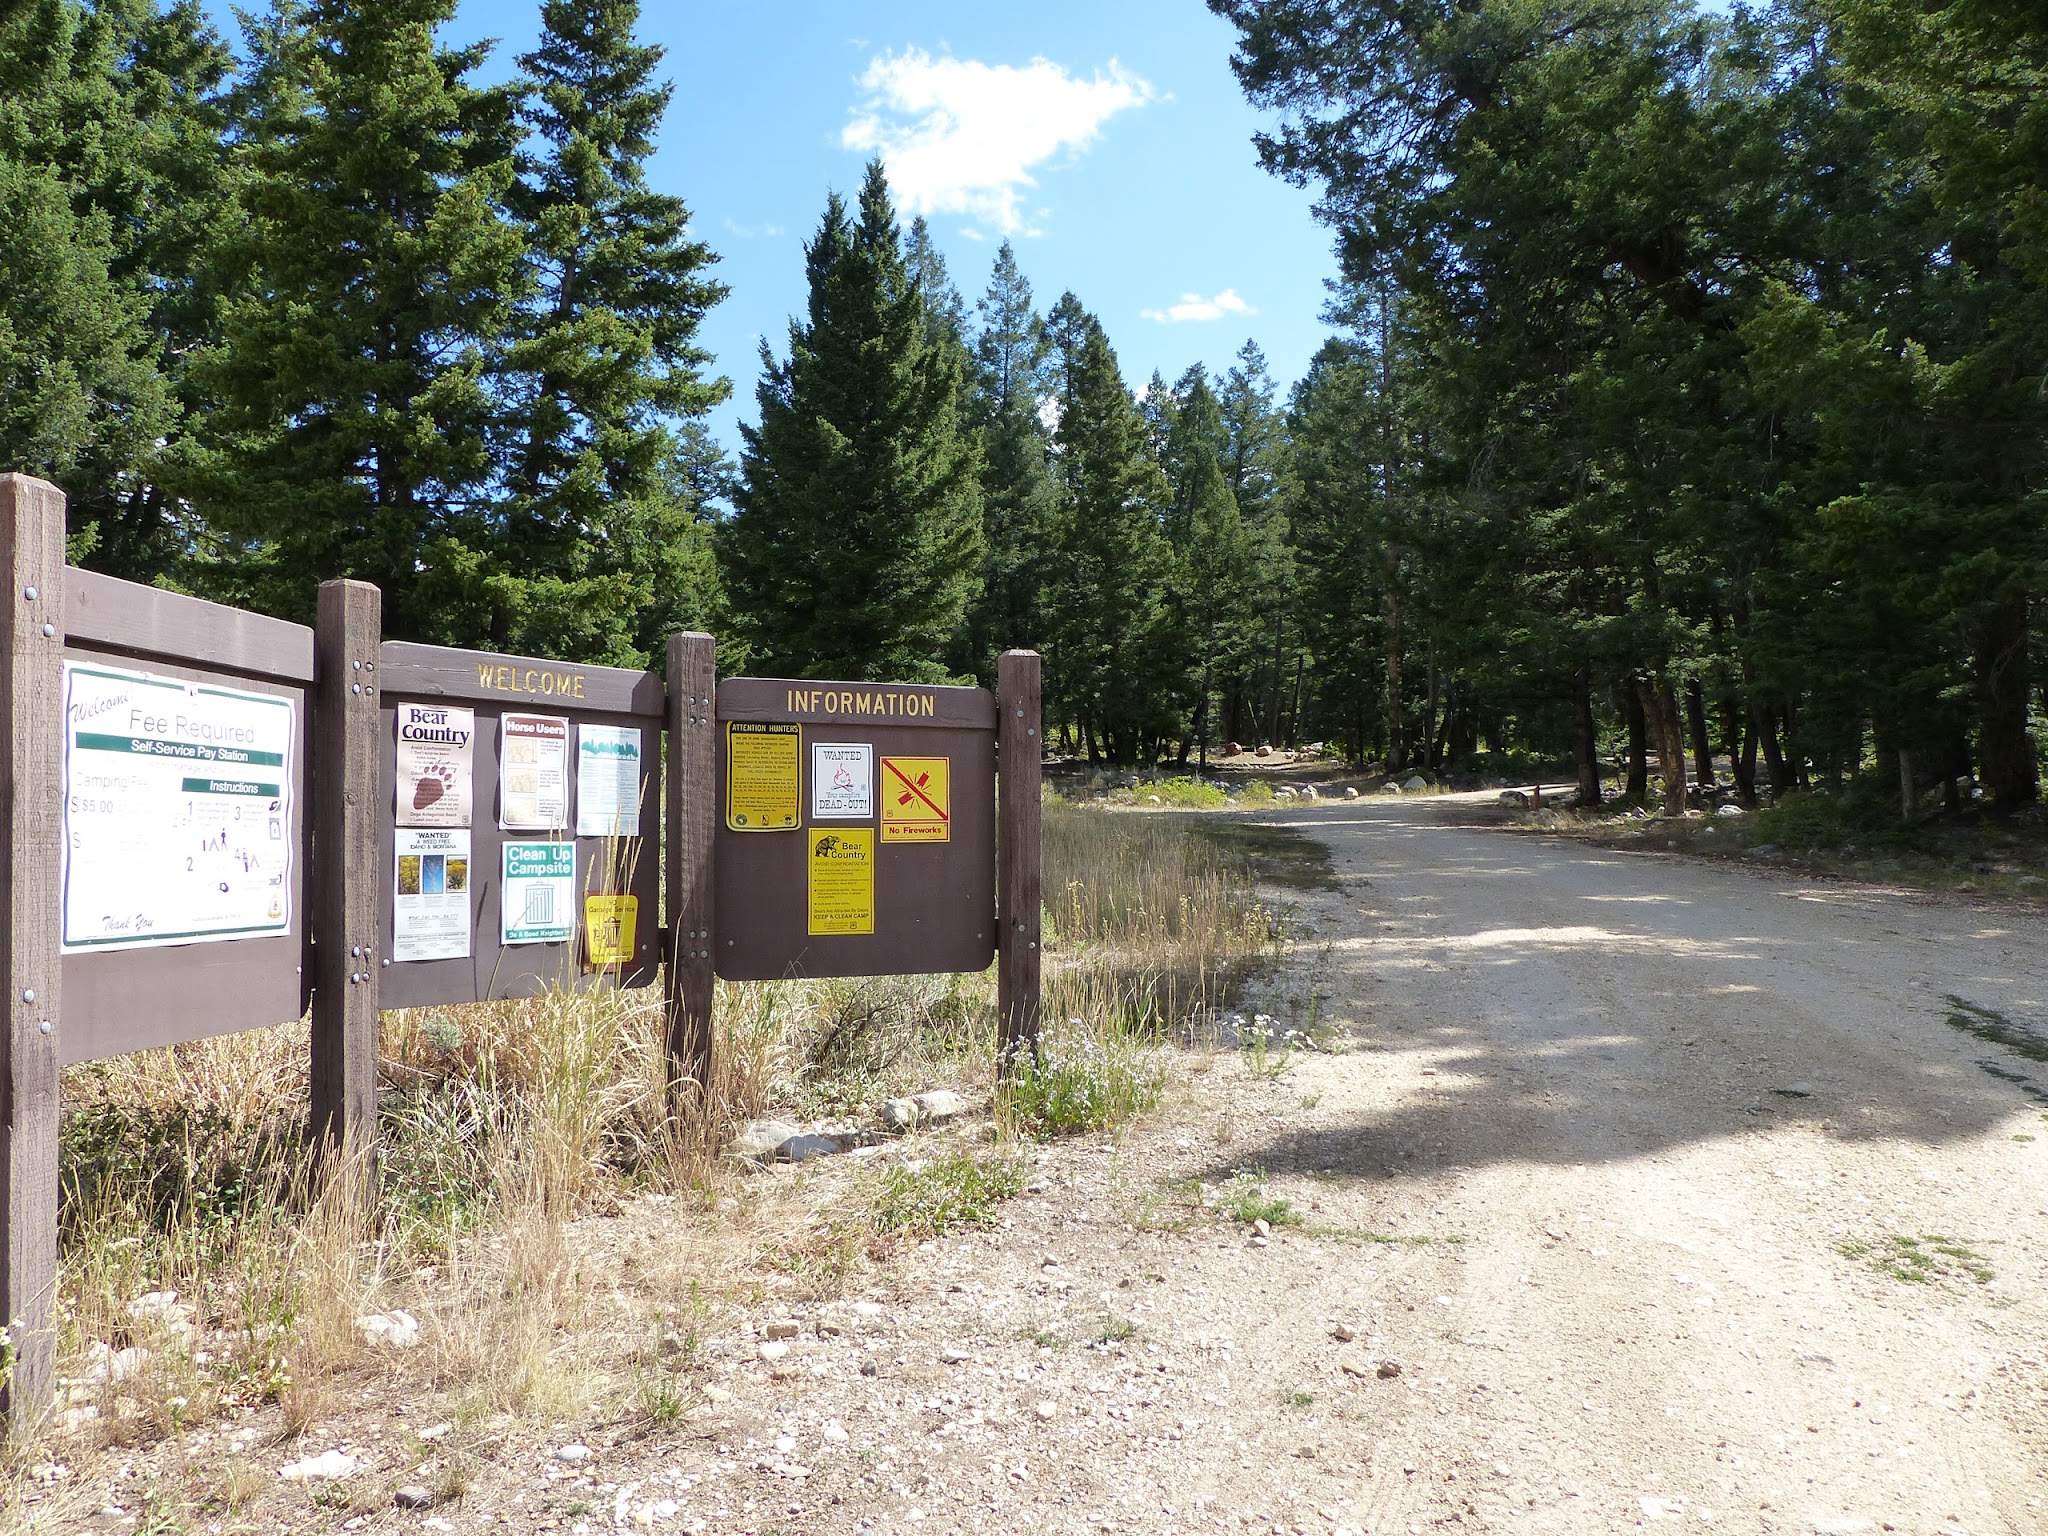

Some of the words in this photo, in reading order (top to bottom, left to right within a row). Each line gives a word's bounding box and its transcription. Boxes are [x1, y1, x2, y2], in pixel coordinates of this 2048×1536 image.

[478, 663, 585, 698] WELCOME
[69, 690, 130, 723] Welcome
[787, 690, 934, 717] INFORMATION
[410, 708, 448, 725] Bear
[130, 709, 168, 734] Fee
[176, 714, 255, 743] Required
[506, 720, 536, 734] Horse
[536, 723, 565, 736] Users
[732, 724, 766, 732] ATTENTION
[768, 724, 798, 733] HUNTERS
[402, 724, 470, 749] Country
[131, 739, 196, 757] Self-Service
[197, 745, 217, 762] Pay
[218, 748, 249, 762] Station
[823, 750, 862, 761] WANTED
[75, 771, 128, 792] Camping
[209, 780, 259, 794] Instructions
[82, 799, 114, 814] $500
[188, 800, 193, 816] 1
[234, 806, 242, 821] 3
[888, 826, 900, 834] No
[903, 826, 942, 834] Fireworks
[842, 842, 862, 850] Bear
[508, 847, 546, 861] Clean
[552, 847, 571, 862] Up
[831, 851, 866, 860] Country
[186, 856, 194, 872] 2
[508, 862, 571, 876] Campsite
[102, 914, 131, 931] Thank
[135, 913, 155, 932] You
[524, 930, 540, 938] Good
